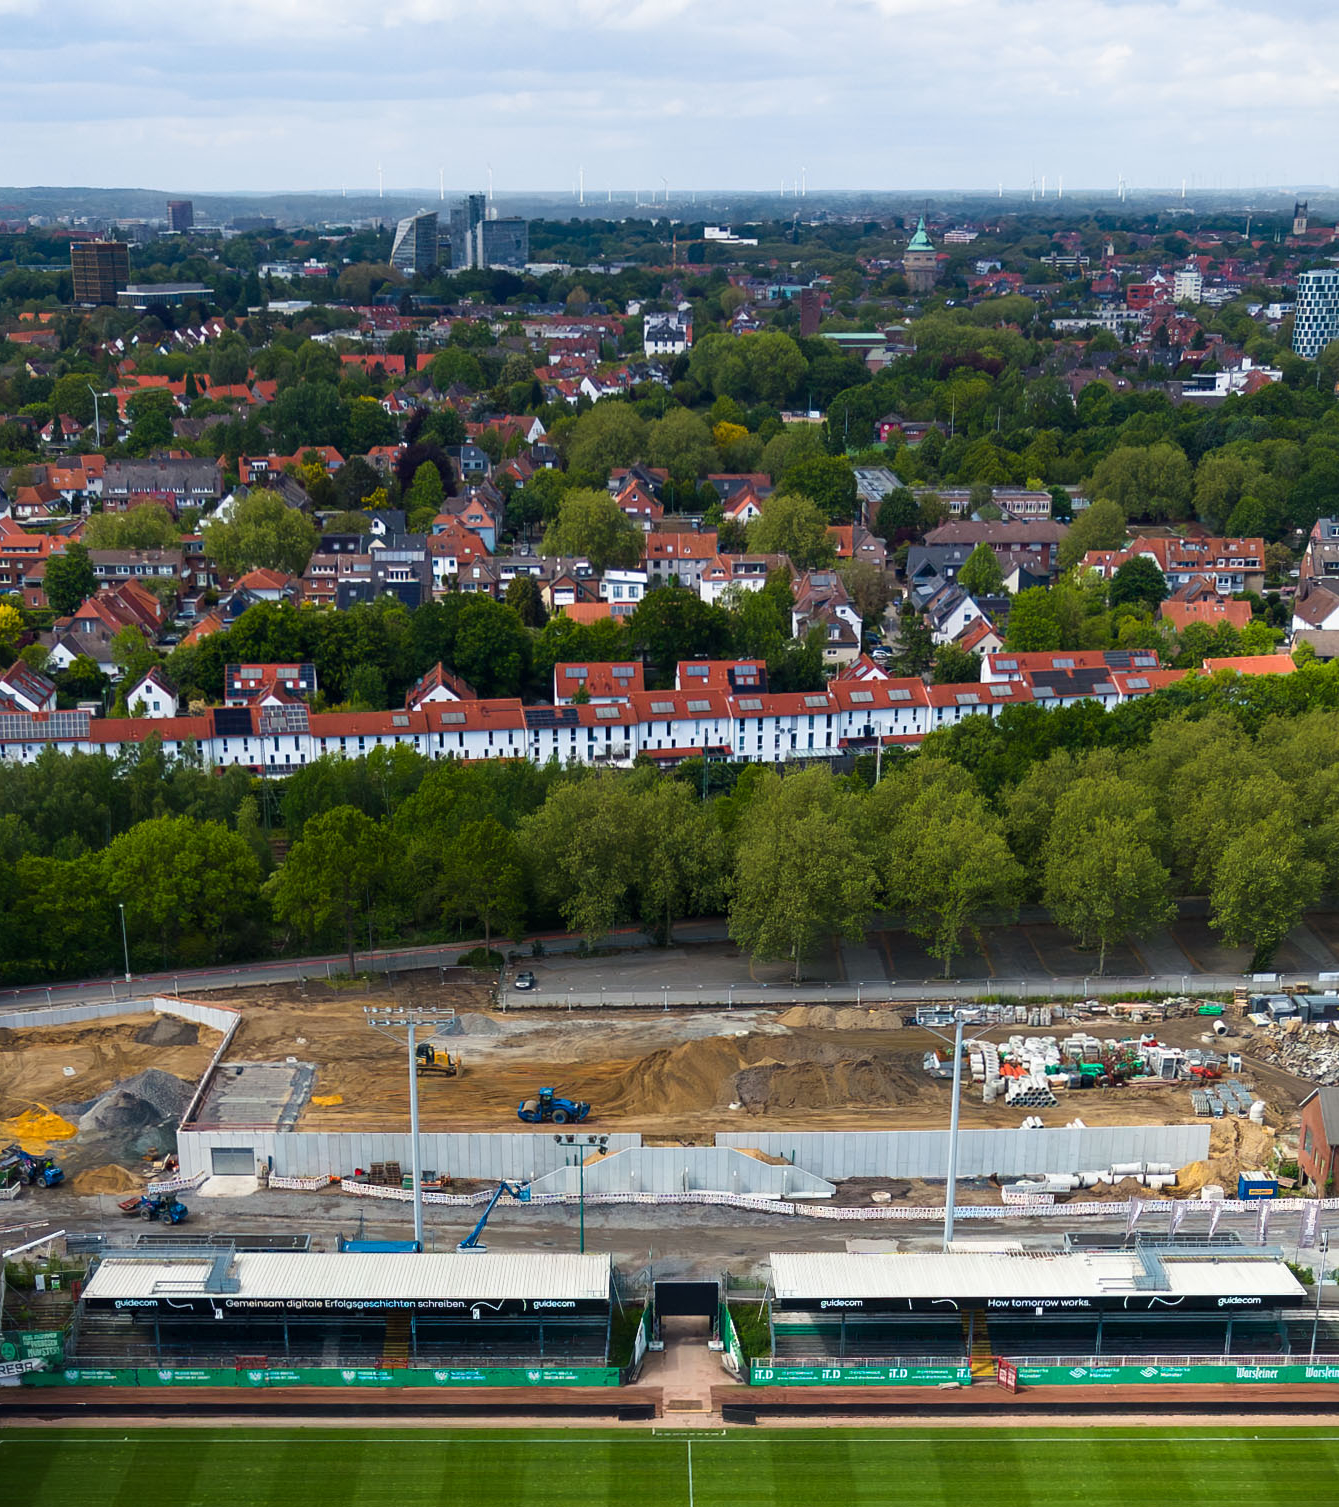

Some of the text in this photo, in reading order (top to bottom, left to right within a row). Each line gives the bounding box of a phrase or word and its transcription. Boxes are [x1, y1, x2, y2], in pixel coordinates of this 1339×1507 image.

[115, 1299, 158, 1308] guidecom
[225, 1299, 467, 1309] Gemeinsam digitale Erfolgsgeschichten schreiben.
[533, 1299, 576, 1309] guidecom
[821, 1298, 863, 1308] guidecom
[988, 1299, 1091, 1307] How tomorrow works.
[1218, 1296, 1261, 1306] guidecom
[1236, 1366, 1278, 1379] Warsteiner
